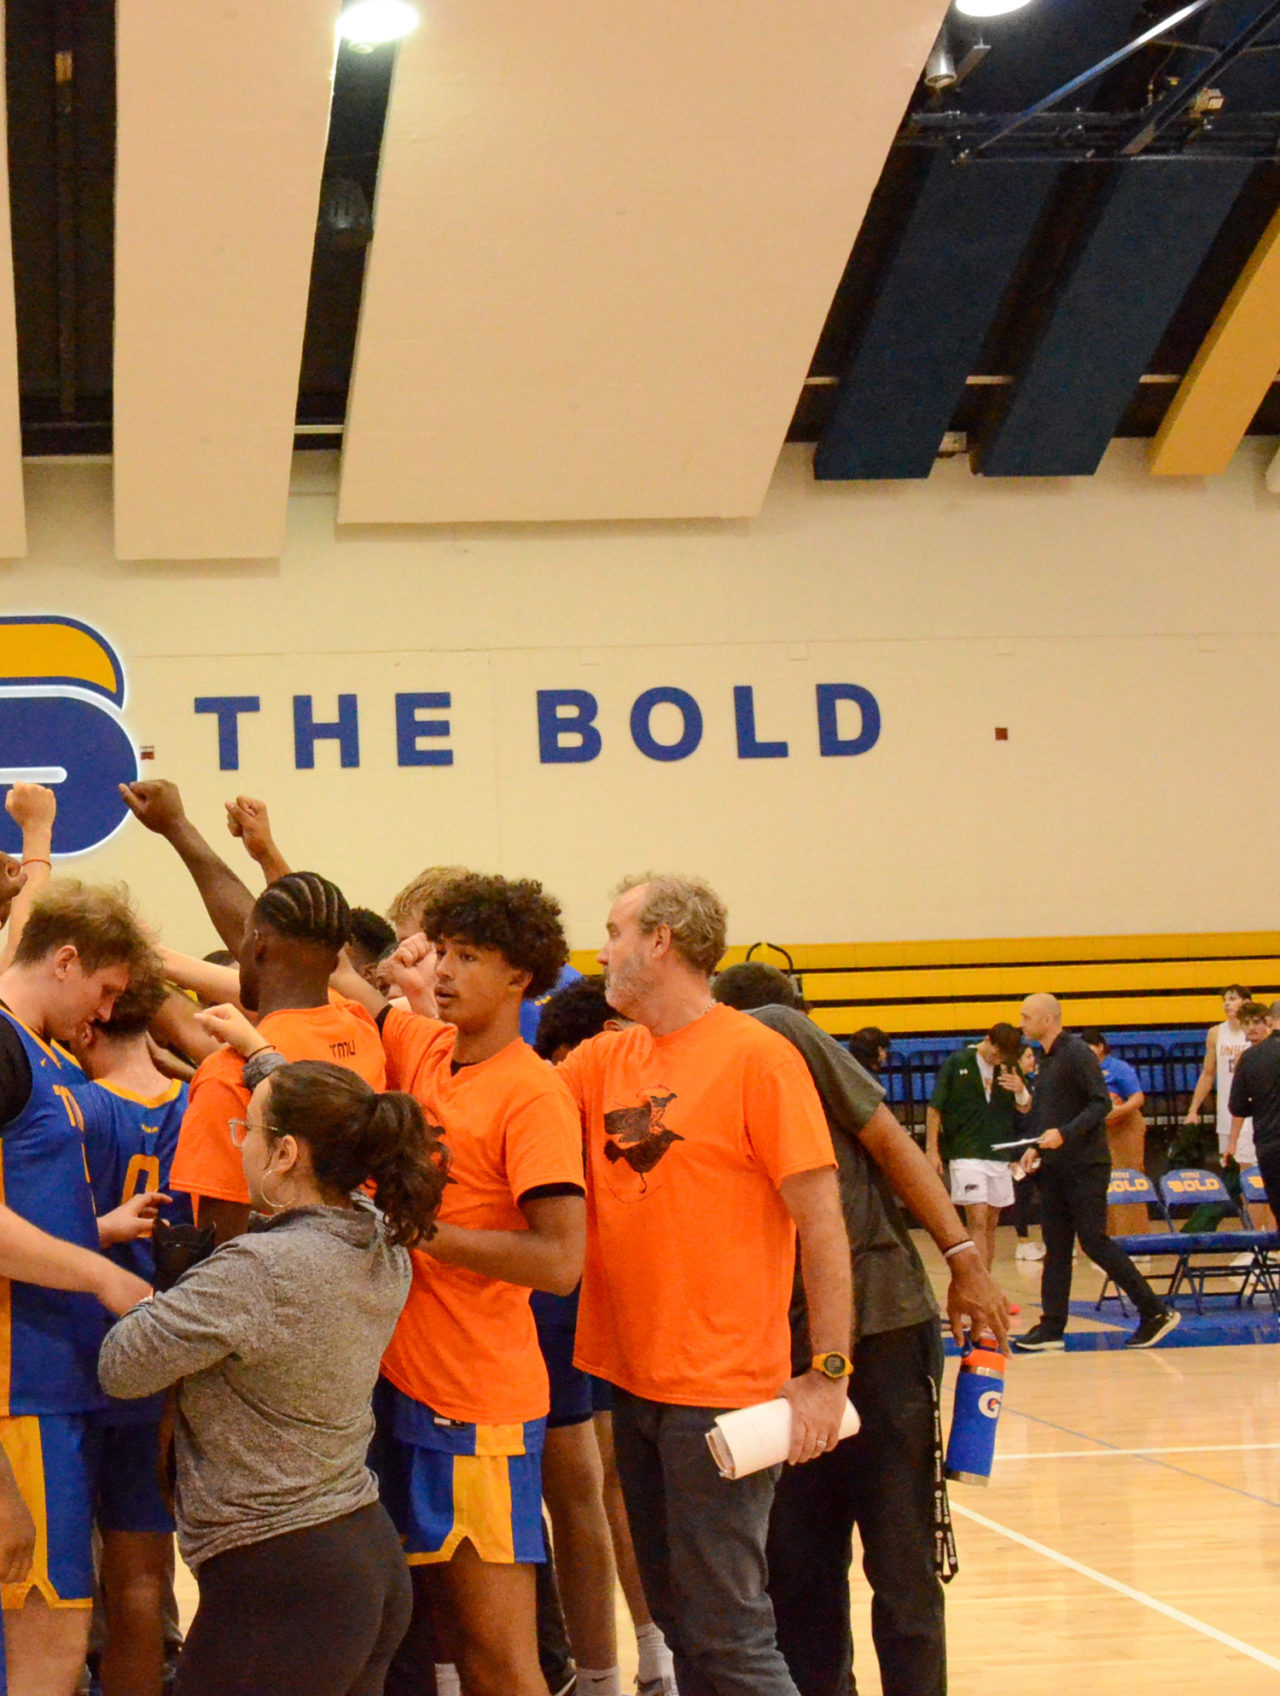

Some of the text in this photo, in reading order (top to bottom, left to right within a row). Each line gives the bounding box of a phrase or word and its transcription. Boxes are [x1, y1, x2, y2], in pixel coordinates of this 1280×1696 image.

[195, 692, 454, 770] THE
[538, 683, 882, 763] BOLD
[328, 1039, 356, 1059] TMU
[1167, 1178, 1221, 1193] BOLD
[978, 1391, 1003, 1419] G
